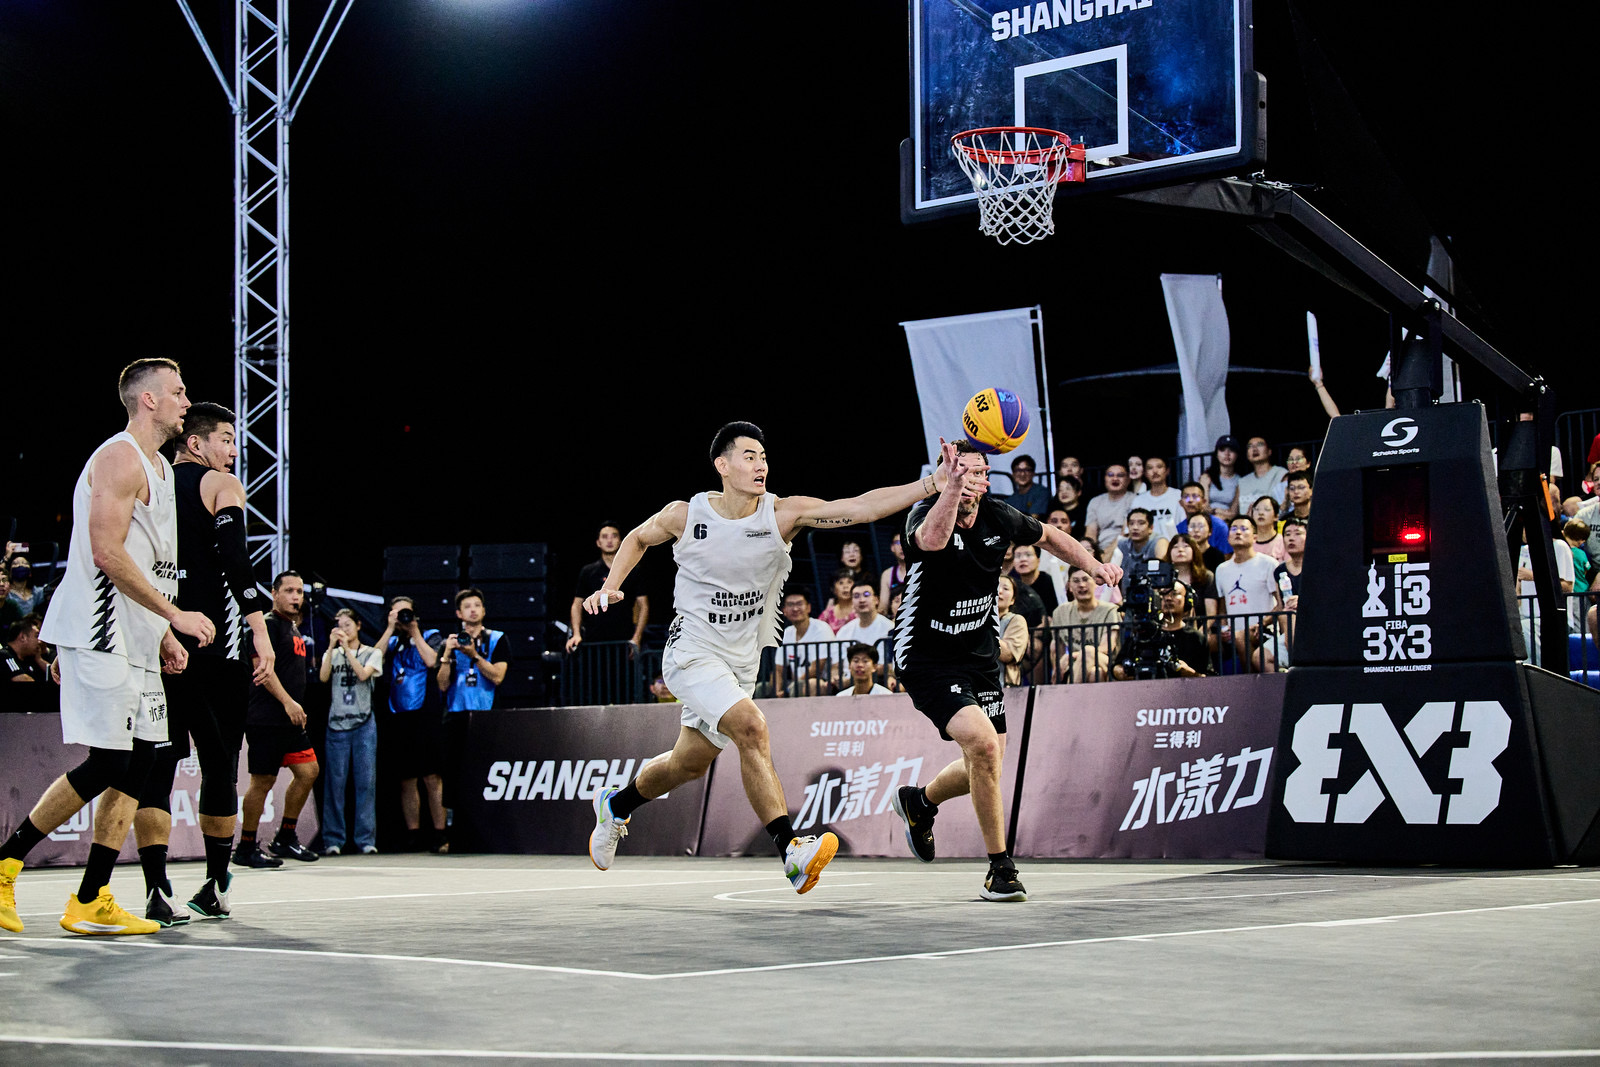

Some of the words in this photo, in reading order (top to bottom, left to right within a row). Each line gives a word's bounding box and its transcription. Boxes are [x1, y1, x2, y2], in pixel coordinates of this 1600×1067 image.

[1399, 447, 1420, 455] Sports
[693, 523, 708, 540] 6
[953, 533, 964, 550] 4
[708, 606, 764, 624] BEIJING
[1385, 620, 1408, 630] FIBA
[1363, 665, 1394, 673] SHANGHAI
[1394, 664, 1432, 672] CHALLENGER
[1153, 730, 1202, 749] 三得利
[823, 741, 865, 757] 三得利
[482, 758, 670, 801] SHANGH
[791, 756, 924, 831] 水漾力
[1118, 746, 1275, 832] 水漾力
